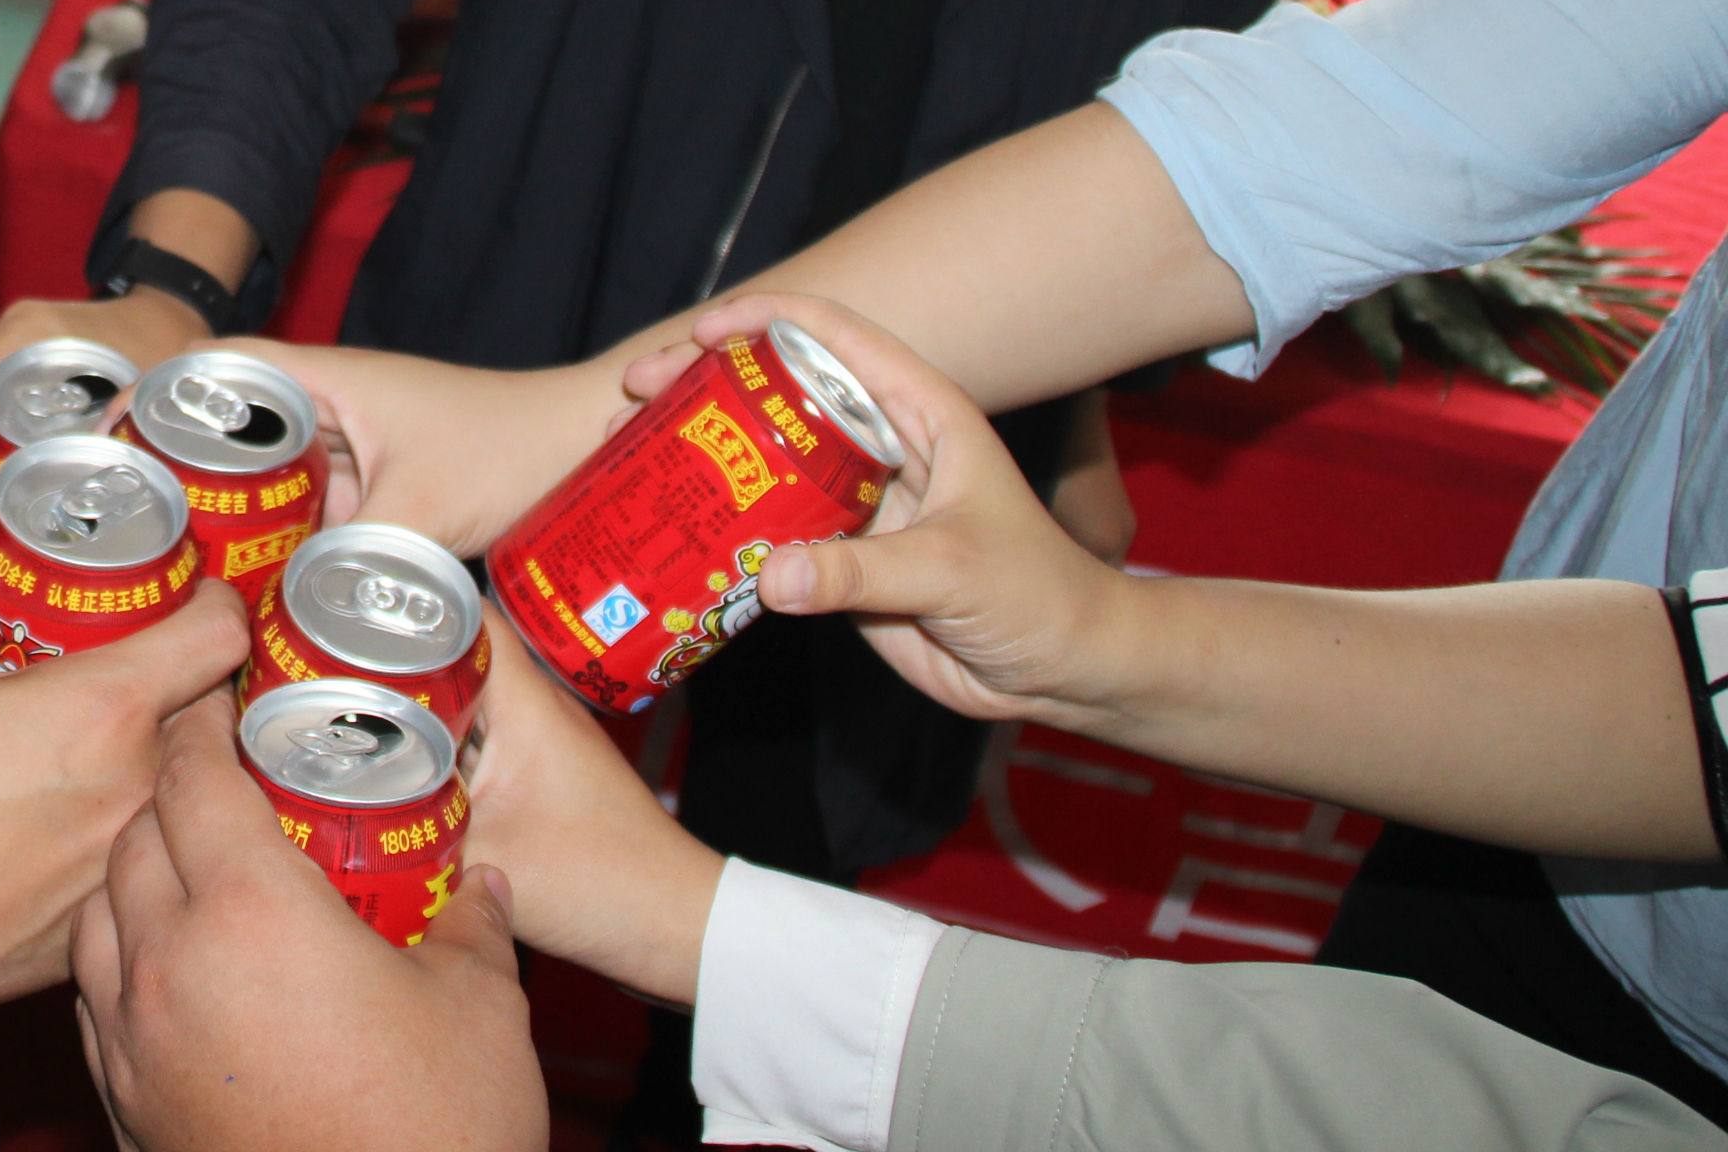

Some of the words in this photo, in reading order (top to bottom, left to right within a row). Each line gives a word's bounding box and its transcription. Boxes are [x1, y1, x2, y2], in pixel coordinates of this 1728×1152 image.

[181, 484, 249, 515] 宗王老吉
[46, 581, 162, 614] 认准正宗王老吉
[379, 818, 439, 856] 180余年
